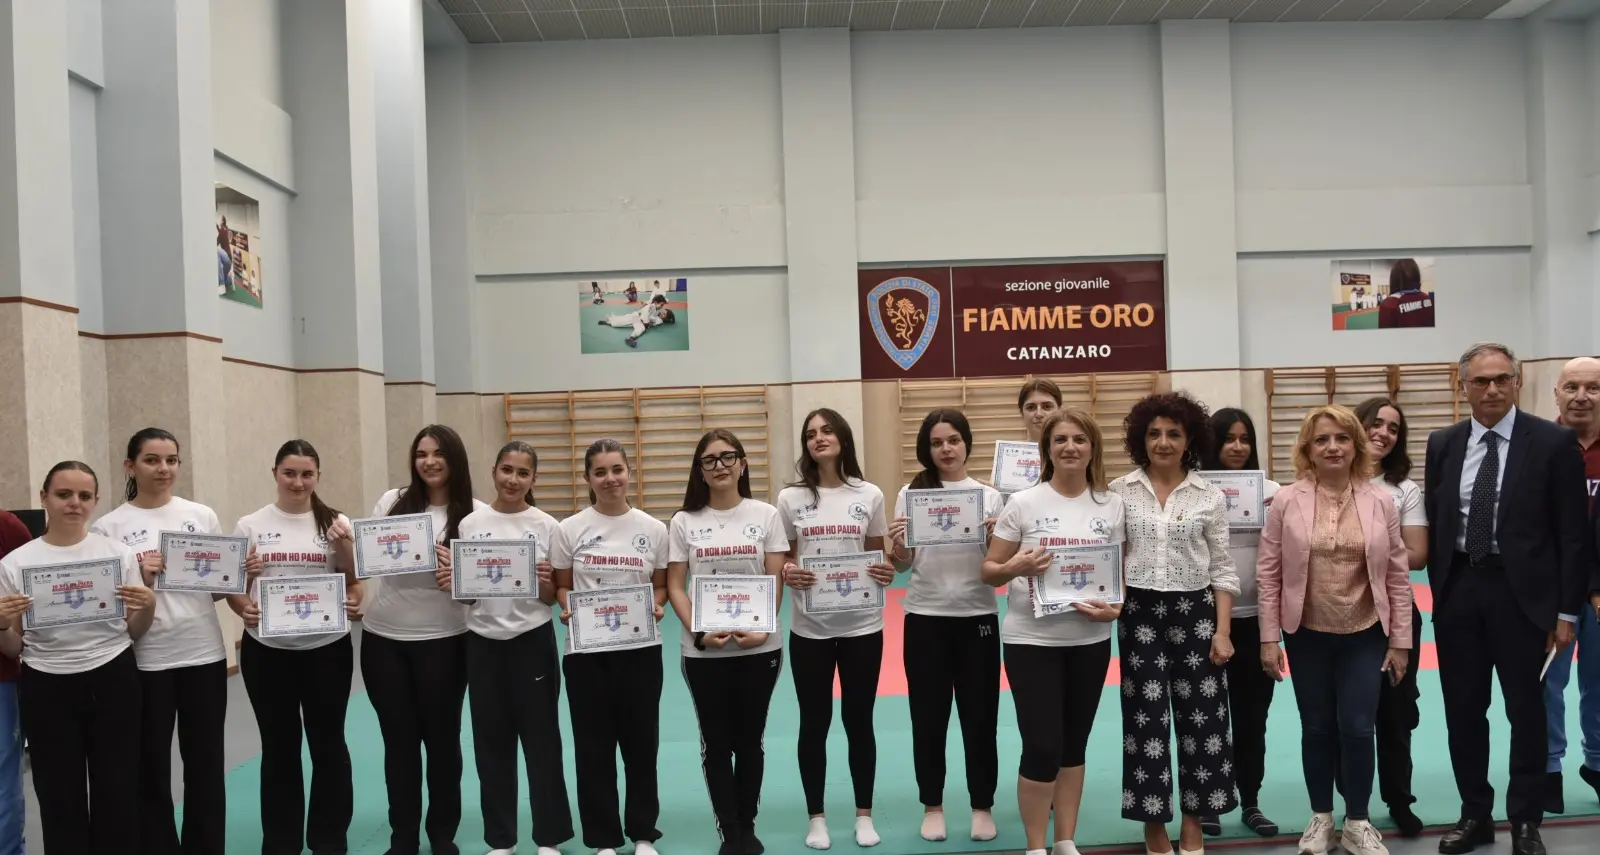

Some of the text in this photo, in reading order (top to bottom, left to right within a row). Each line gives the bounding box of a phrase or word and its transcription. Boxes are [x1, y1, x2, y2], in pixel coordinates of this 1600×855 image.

[1005, 277, 1110, 293] sezione giovanile
[963, 302, 1155, 332] FIAMME ORO
[1006, 344, 1112, 361] CATANZARO
[809, 525, 825, 536] NON
[825, 525, 837, 535] HO
[837, 524, 861, 535] PAURA
[1040, 537, 1048, 547] IO
[1049, 537, 1067, 547] NON
[262, 552, 327, 563] IO NON HO PAURA
[696, 544, 758, 558] IO NON HO PAURA
[591, 555, 607, 565] NON
[607, 555, 619, 566] HO
[619, 556, 644, 568] PAURA
